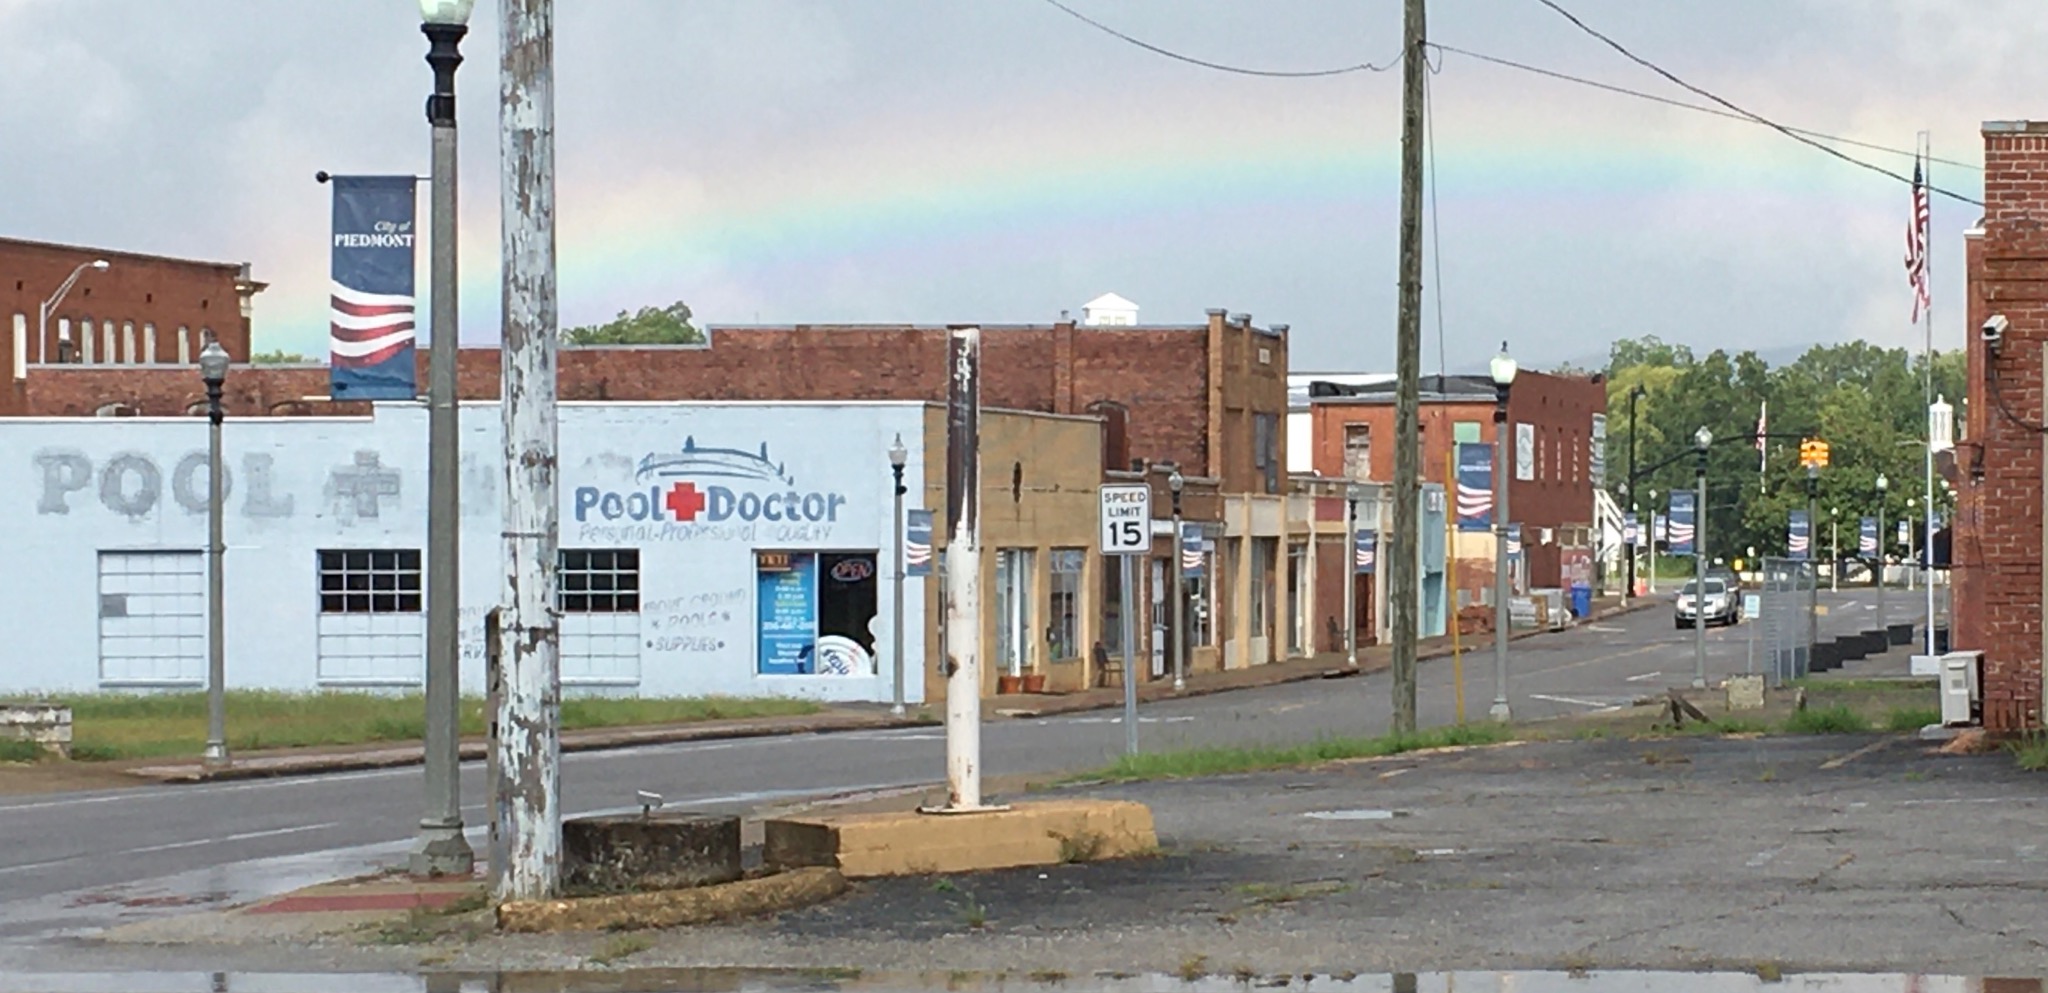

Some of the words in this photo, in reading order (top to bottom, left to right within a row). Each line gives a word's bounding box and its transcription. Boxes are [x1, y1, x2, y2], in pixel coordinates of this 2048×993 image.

[335, 234, 414, 247] PIEDMONT
[35, 452, 294, 519] POOL
[575, 485, 665, 521] Pool
[707, 485, 846, 522] Doctor
[1104, 492, 1146, 503] SPEED
[1108, 507, 1141, 517] LIMIT
[1109, 521, 1142, 546] 15
[836, 562, 869, 578] OPEN
[656, 636, 716, 651] SUPPLIES
